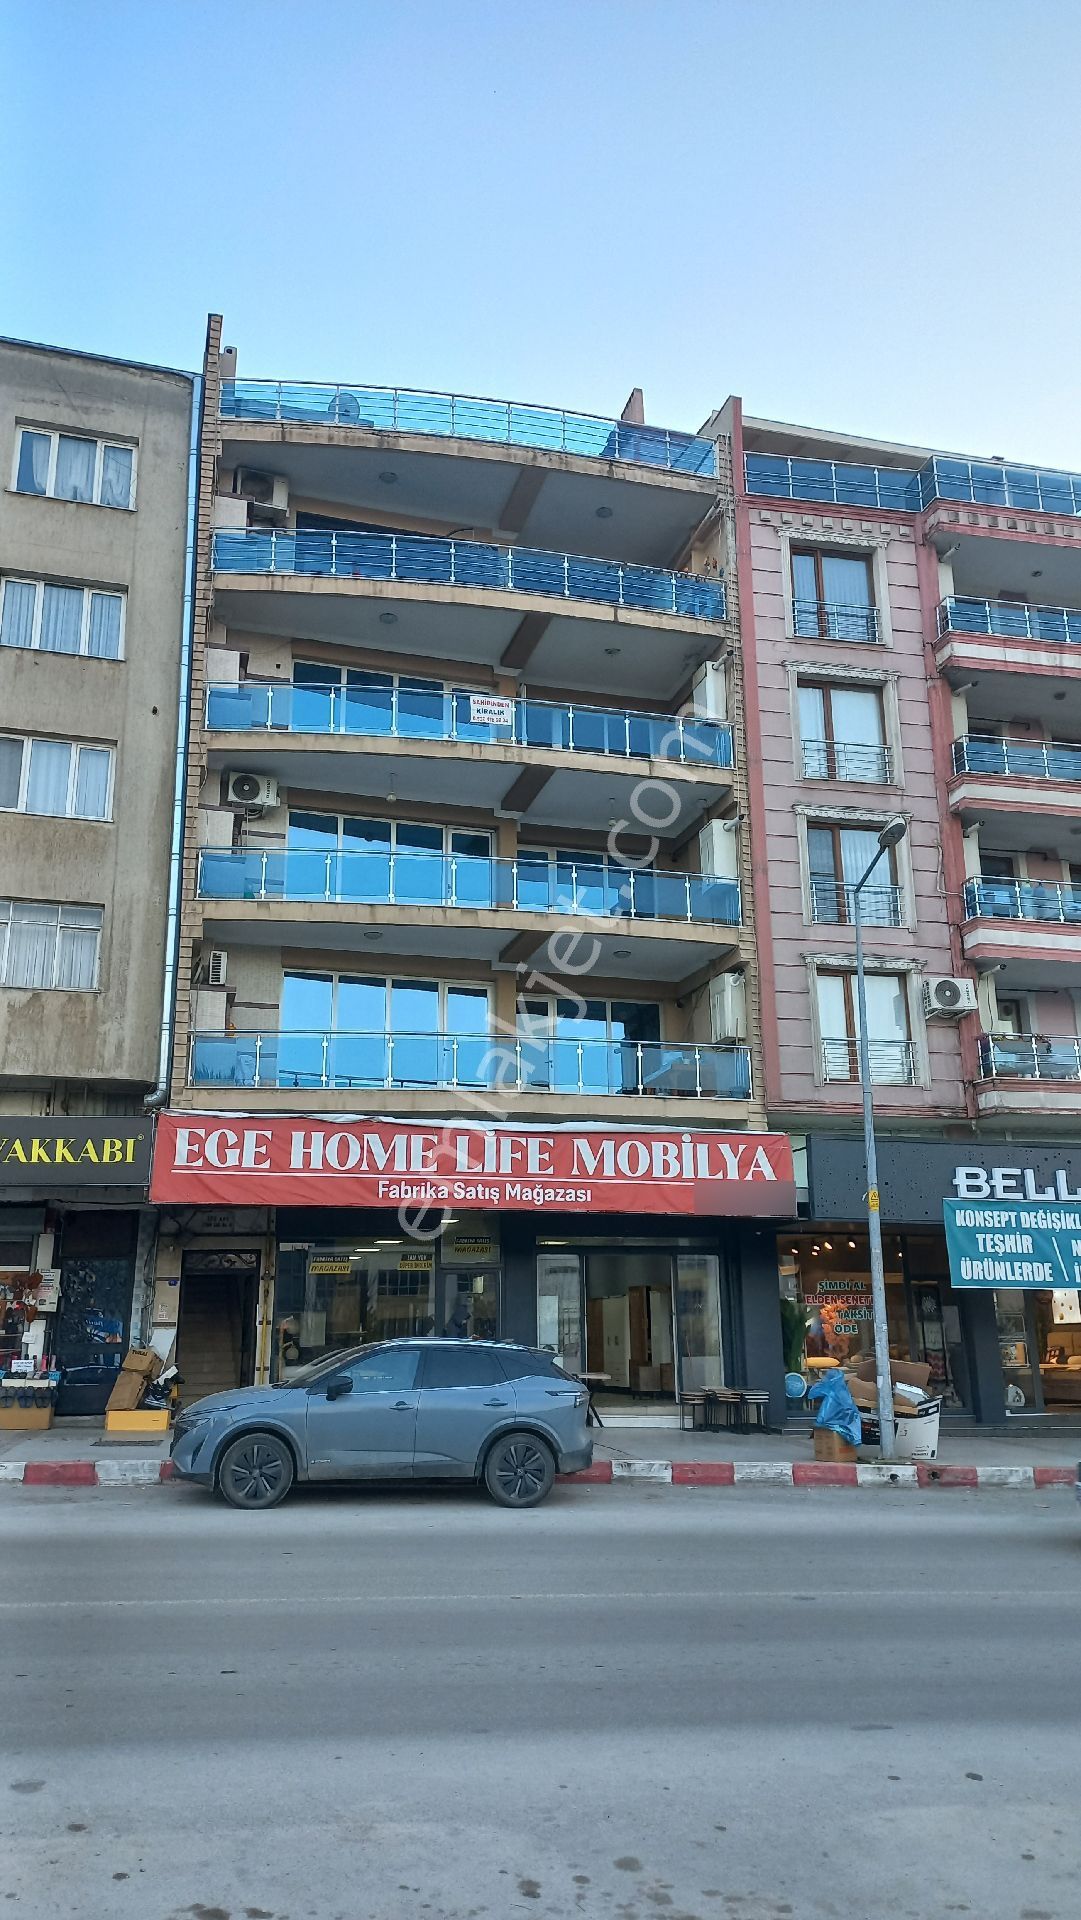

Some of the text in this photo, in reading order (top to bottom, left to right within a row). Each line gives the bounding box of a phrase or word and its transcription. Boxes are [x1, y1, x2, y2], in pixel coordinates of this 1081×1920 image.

[173, 1128, 777, 1181] EGE HOME LİFE MOBİLYA
[378, 1180, 592, 1206] Fabrika Satış Mağazası
[955, 1209, 1018, 1228] KONSEPT
[976, 1231, 1034, 1257] TEŞHİR
[960, 1257, 1054, 1282] ÜRÜNLERDE
[818, 1279, 866, 1293] ŞİMDİ AL
[805, 1294, 874, 1305] ELDEN SENET
[834, 1321, 858, 1334] ÖDE
